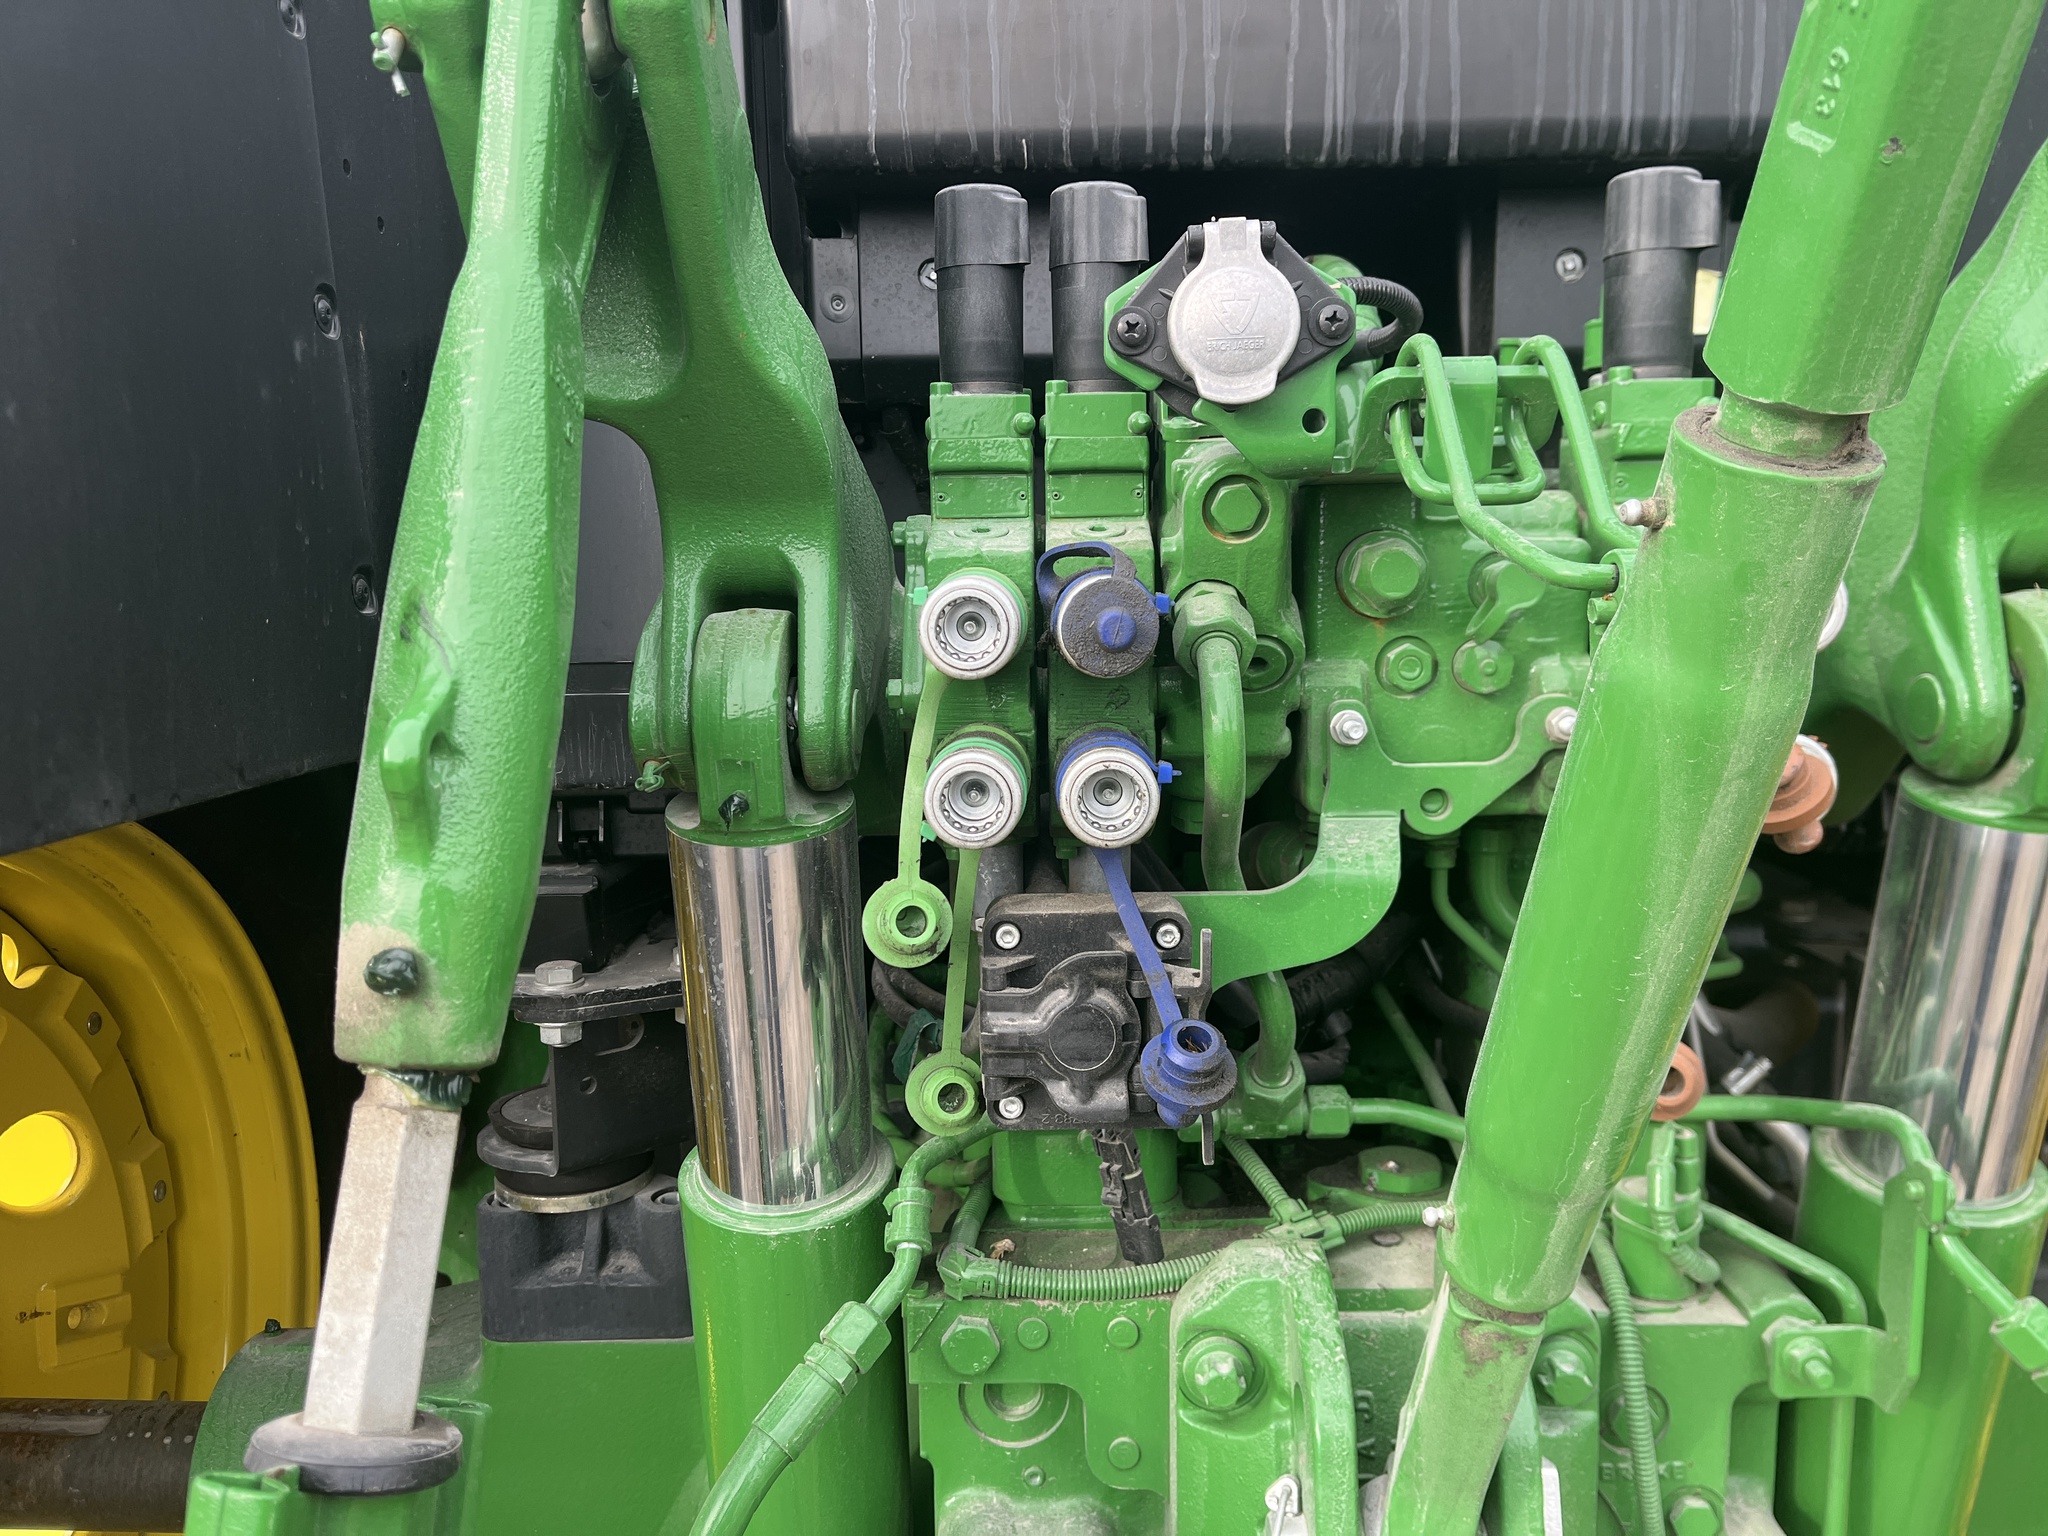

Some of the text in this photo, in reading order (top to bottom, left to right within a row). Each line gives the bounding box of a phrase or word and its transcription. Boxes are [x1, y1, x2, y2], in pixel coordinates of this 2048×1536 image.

[1206, 339, 1265, 353] ERICH JAEGER
[1041, 1113, 1087, 1125] 783-2
[1601, 1461, 1685, 1480] BRKE
